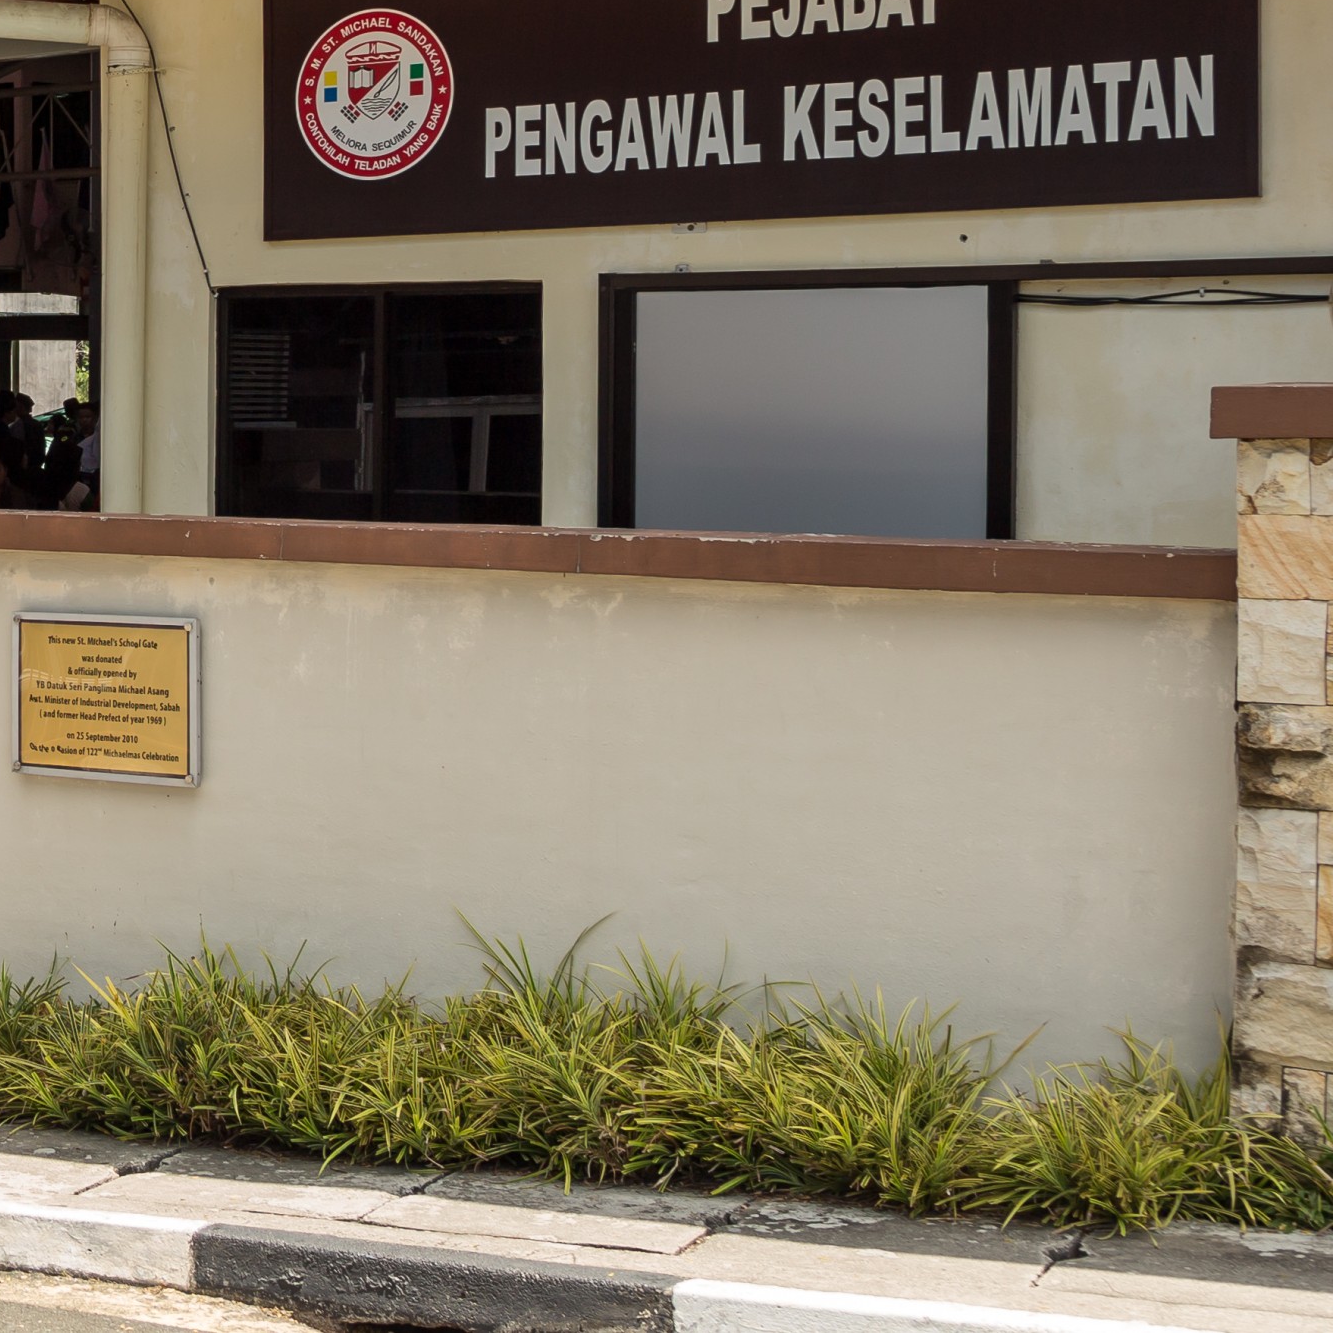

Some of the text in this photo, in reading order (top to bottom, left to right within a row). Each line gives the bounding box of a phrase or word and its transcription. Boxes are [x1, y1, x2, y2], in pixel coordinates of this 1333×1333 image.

[305, 17, 444, 86] S. M. ST. MICHAEL SANDAKAN
[483, 54, 1216, 179] PENGAWAL KESELAMATAN
[305, 103, 444, 171] CONTOHILAH TELADAN YANG BAIK
[330, 120, 417, 152] MELIORA SEQUIMUR
[48, 635, 157, 650] This new St. Michael's School Gate
[95, 654, 122, 664] donated
[68, 667, 137, 680] & officially opened by
[36, 680, 169, 698] YB Datuk Seri Panglima Michael Asang
[44, 695, 70, 705] Minister
[72, 697, 79, 705] of
[80, 698, 111, 708] Industrial
[113, 701, 158, 712] Development,
[160, 703, 180, 712] Sabah
[43, 710, 56, 718] and
[57, 710, 78, 720] former
[80, 712, 96, 721] Head
[98, 713, 121, 722] Prefect
[122, 714, 129, 723] of
[130, 716, 145, 725] year
[146, 716, 162, 725] 1969
[76, 731, 84, 739] 25
[86, 732, 120, 743] September
[122, 734, 138, 744] 2010
[39, 743, 49, 753] the
[78, 747, 85, 755] of
[103, 748, 140, 760] Michaelmas
[142, 750, 179, 762] Celebration
